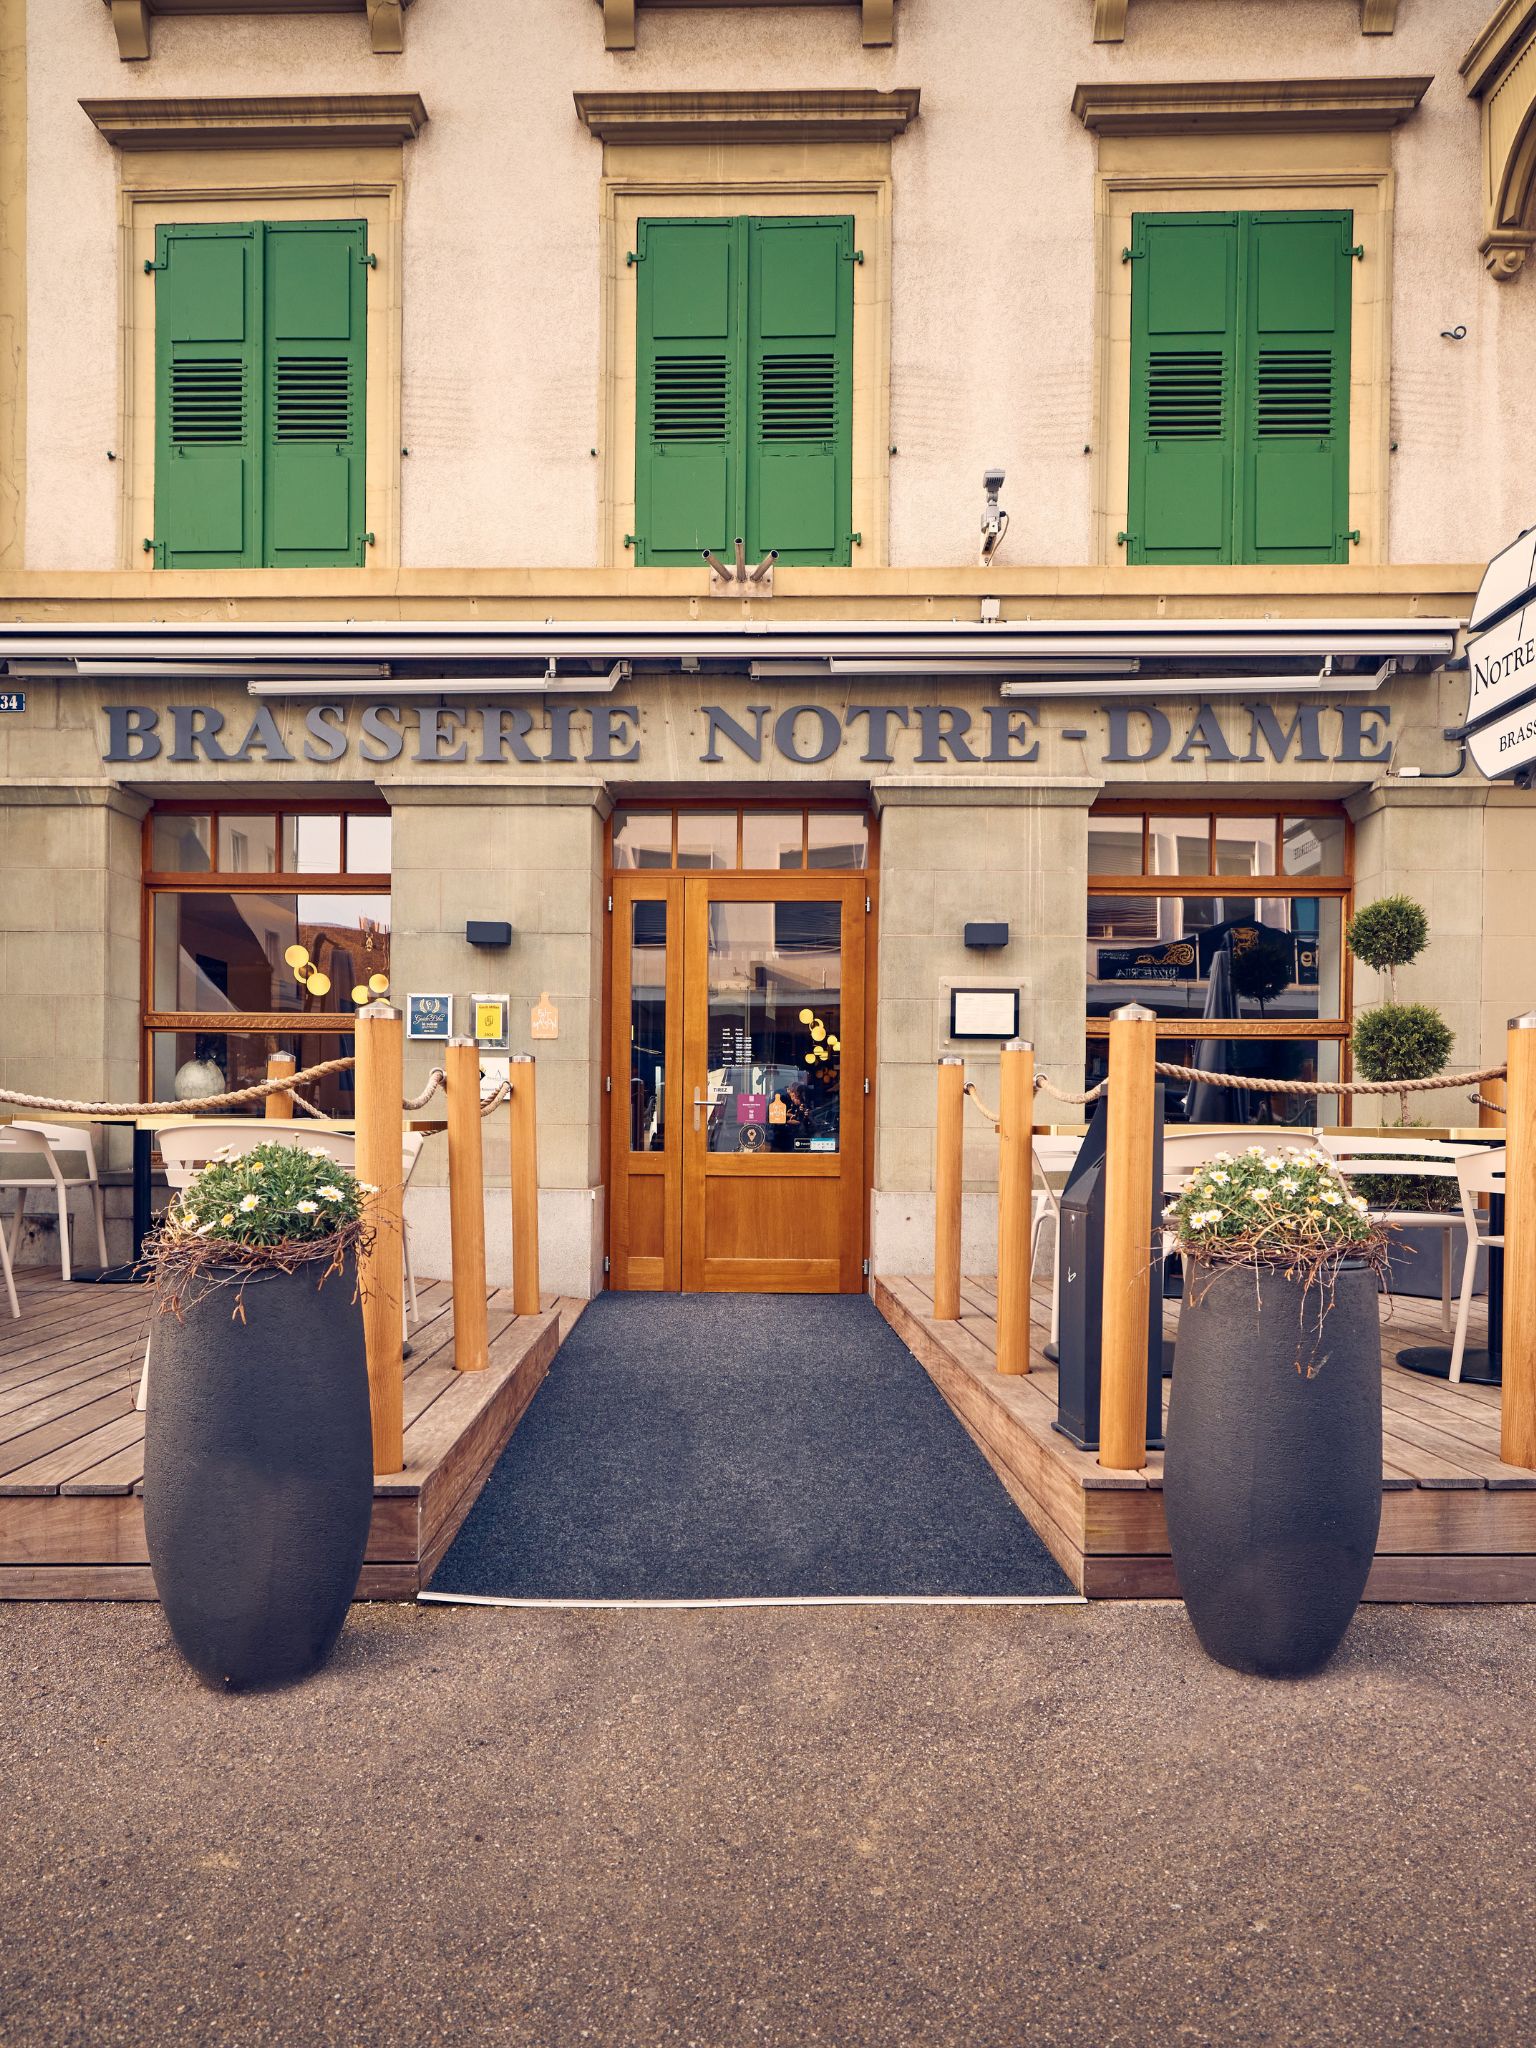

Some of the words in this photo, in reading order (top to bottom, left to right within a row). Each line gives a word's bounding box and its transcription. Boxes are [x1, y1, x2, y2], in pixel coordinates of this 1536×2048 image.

[1474, 638, 1536, 696] NOTRE
[0, 695, 18, 710] 34
[102, 704, 641, 763] BRASSERIE
[699, 704, 1394, 763] NOTRE-DAME
